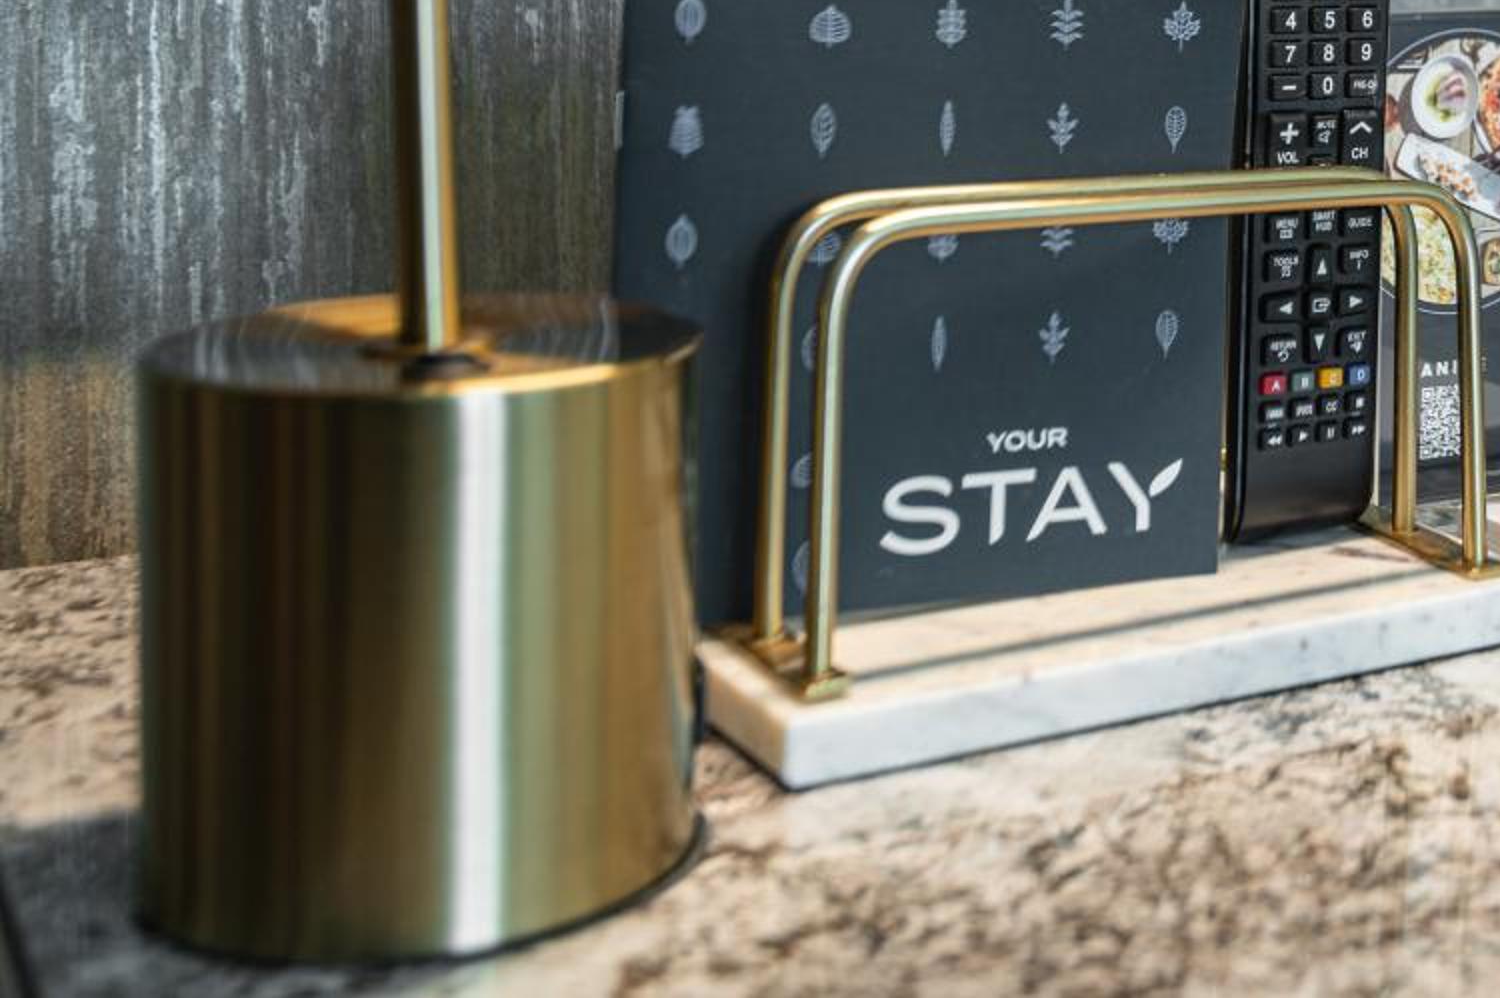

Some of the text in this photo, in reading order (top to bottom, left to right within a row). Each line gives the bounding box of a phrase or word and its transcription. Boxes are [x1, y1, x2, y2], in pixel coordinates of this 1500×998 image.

[1285, 11, 1296, 30] 4
[1325, 11, 1335, 29] 5
[1362, 10, 1373, 28] 6
[1285, 45, 1297, 64] 7
[1323, 43, 1335, 62] 8
[1361, 43, 1372, 61] 9
[1323, 75, 1333, 94] 0
[1277, 151, 1299, 164] VOL
[1351, 146, 1369, 160] CH
[1276, 218, 1298, 230] MENU
[1347, 217, 1373, 228] GUIDE
[1272, 380, 1281, 392] A
[987, 426, 1069, 453] YOUR
[879, 458, 1183, 556] STAY
